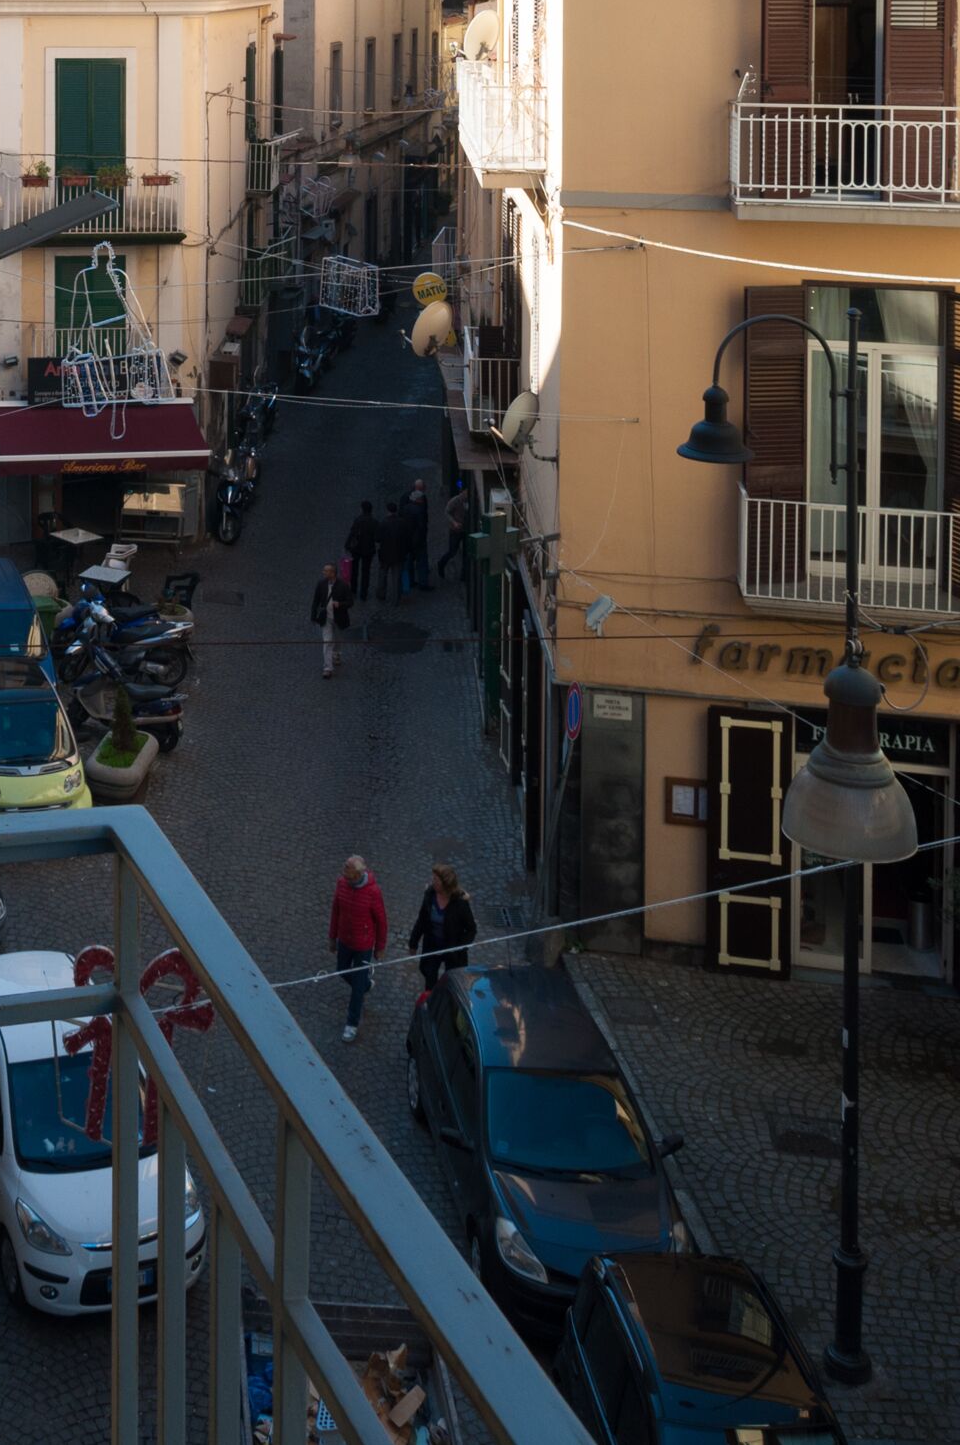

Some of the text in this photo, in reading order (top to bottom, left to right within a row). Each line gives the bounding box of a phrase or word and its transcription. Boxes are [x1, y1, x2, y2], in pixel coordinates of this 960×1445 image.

[417, 283, 446, 299] MATIC
[61, 458, 147, 473] American Bar
[690, 623, 960, 689] farmcia
[811, 726, 936, 753] FRAPIA
